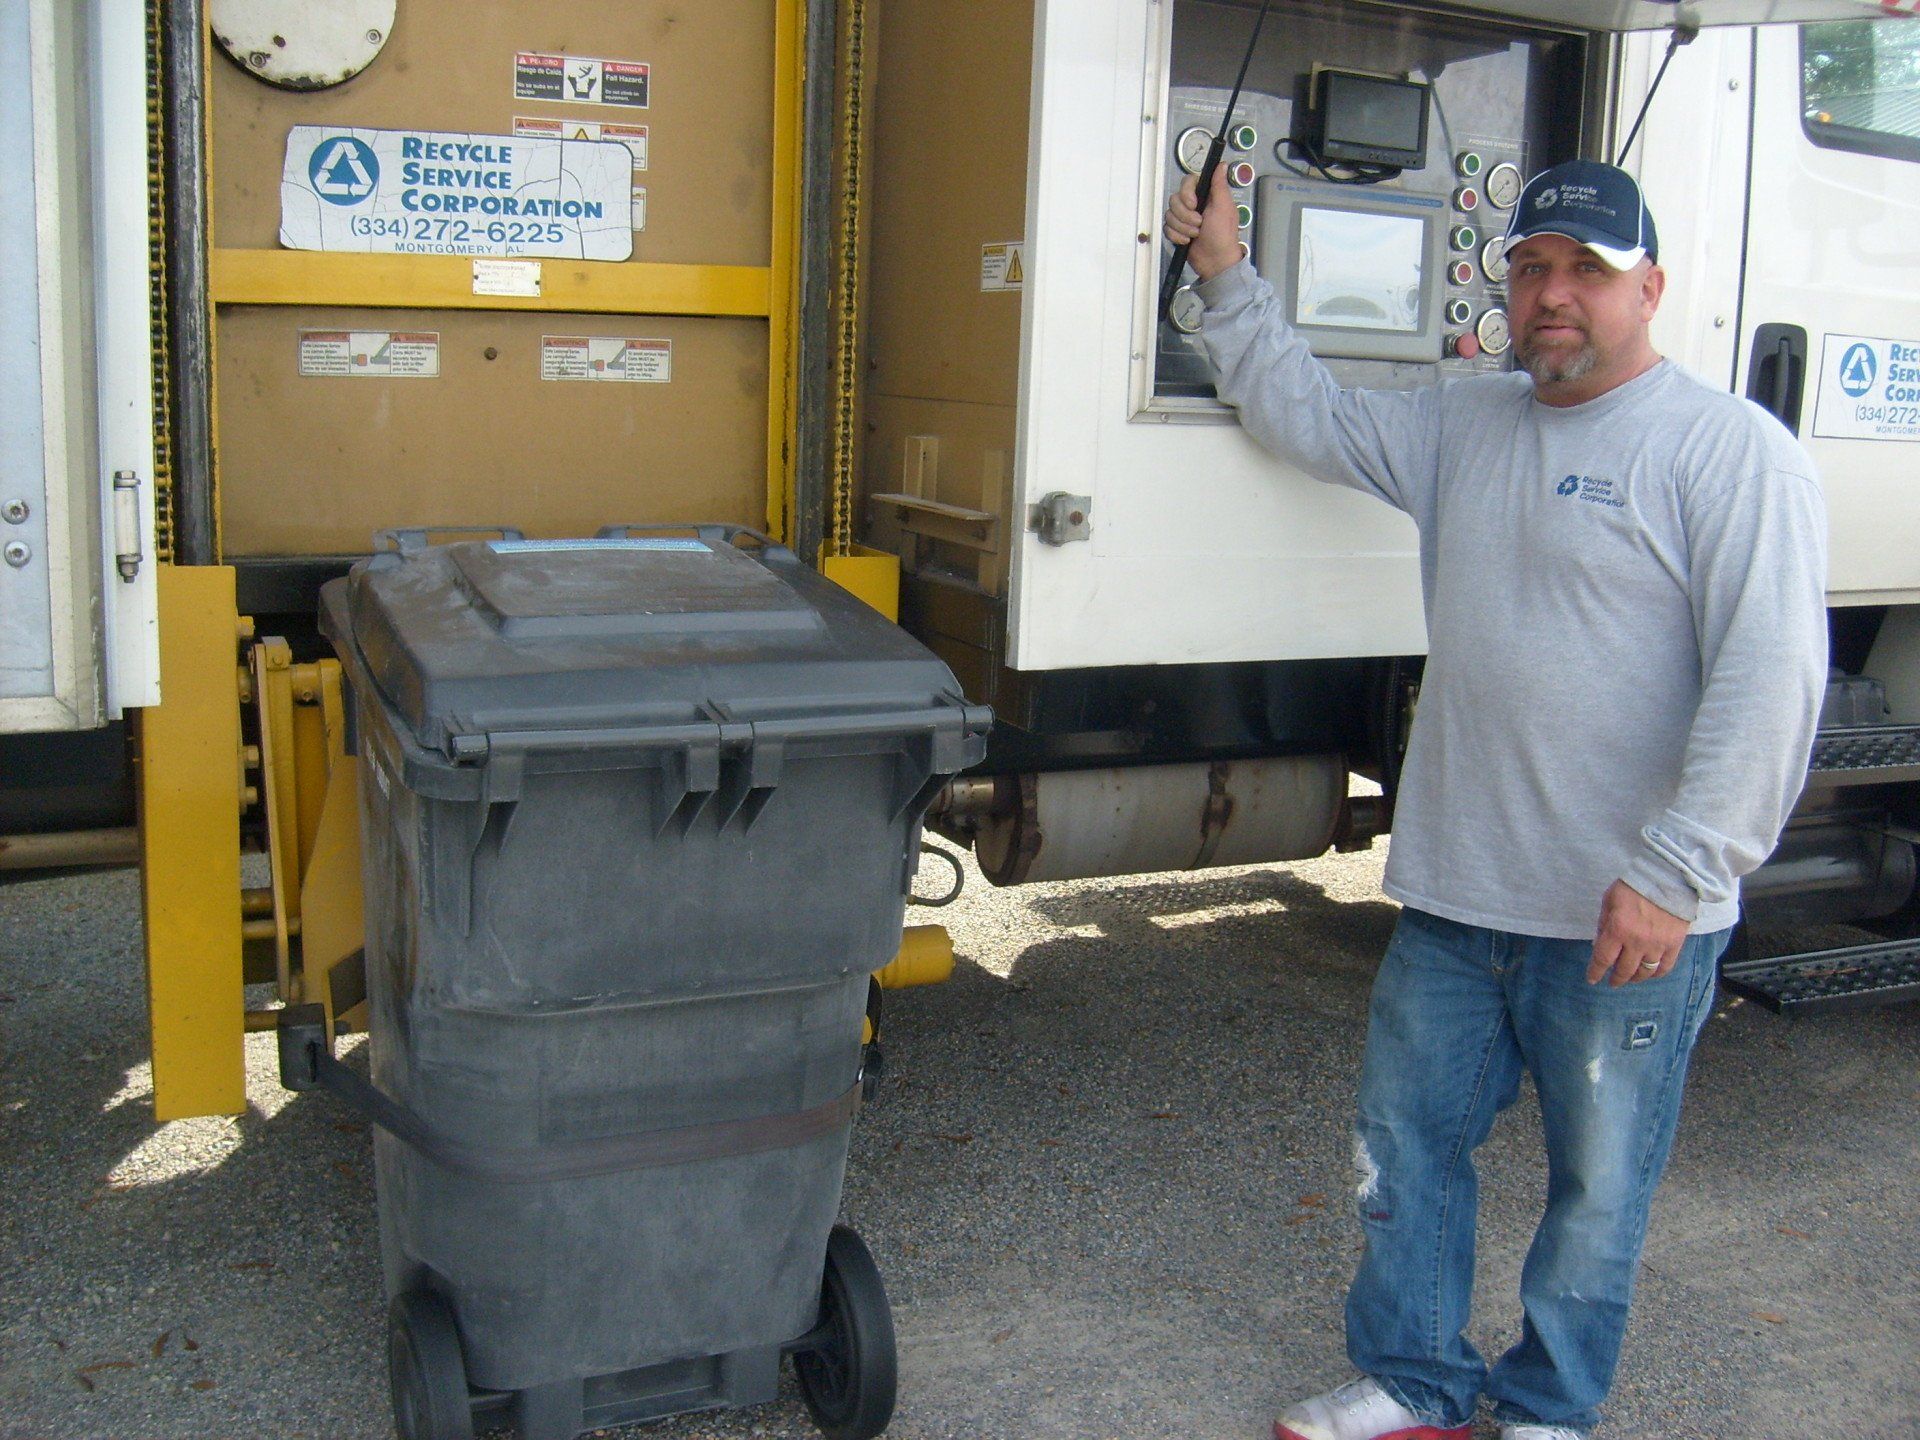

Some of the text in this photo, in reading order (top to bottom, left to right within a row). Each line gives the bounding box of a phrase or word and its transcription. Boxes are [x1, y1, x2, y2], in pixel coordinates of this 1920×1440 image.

[619, 75, 644, 84] Hazard.
[402, 137, 512, 165] RECYCLE
[402, 162, 512, 189] SERVICE
[1561, 184, 1597, 195] Recycle
[1562, 192, 1598, 202] Service
[401, 189, 602, 219] CORPORATION
[506, 244, 524, 254] AL
[1890, 343, 1920, 363] REC
[1582, 475, 1613, 487] Recycle
[1581, 484, 1612, 496] Service
